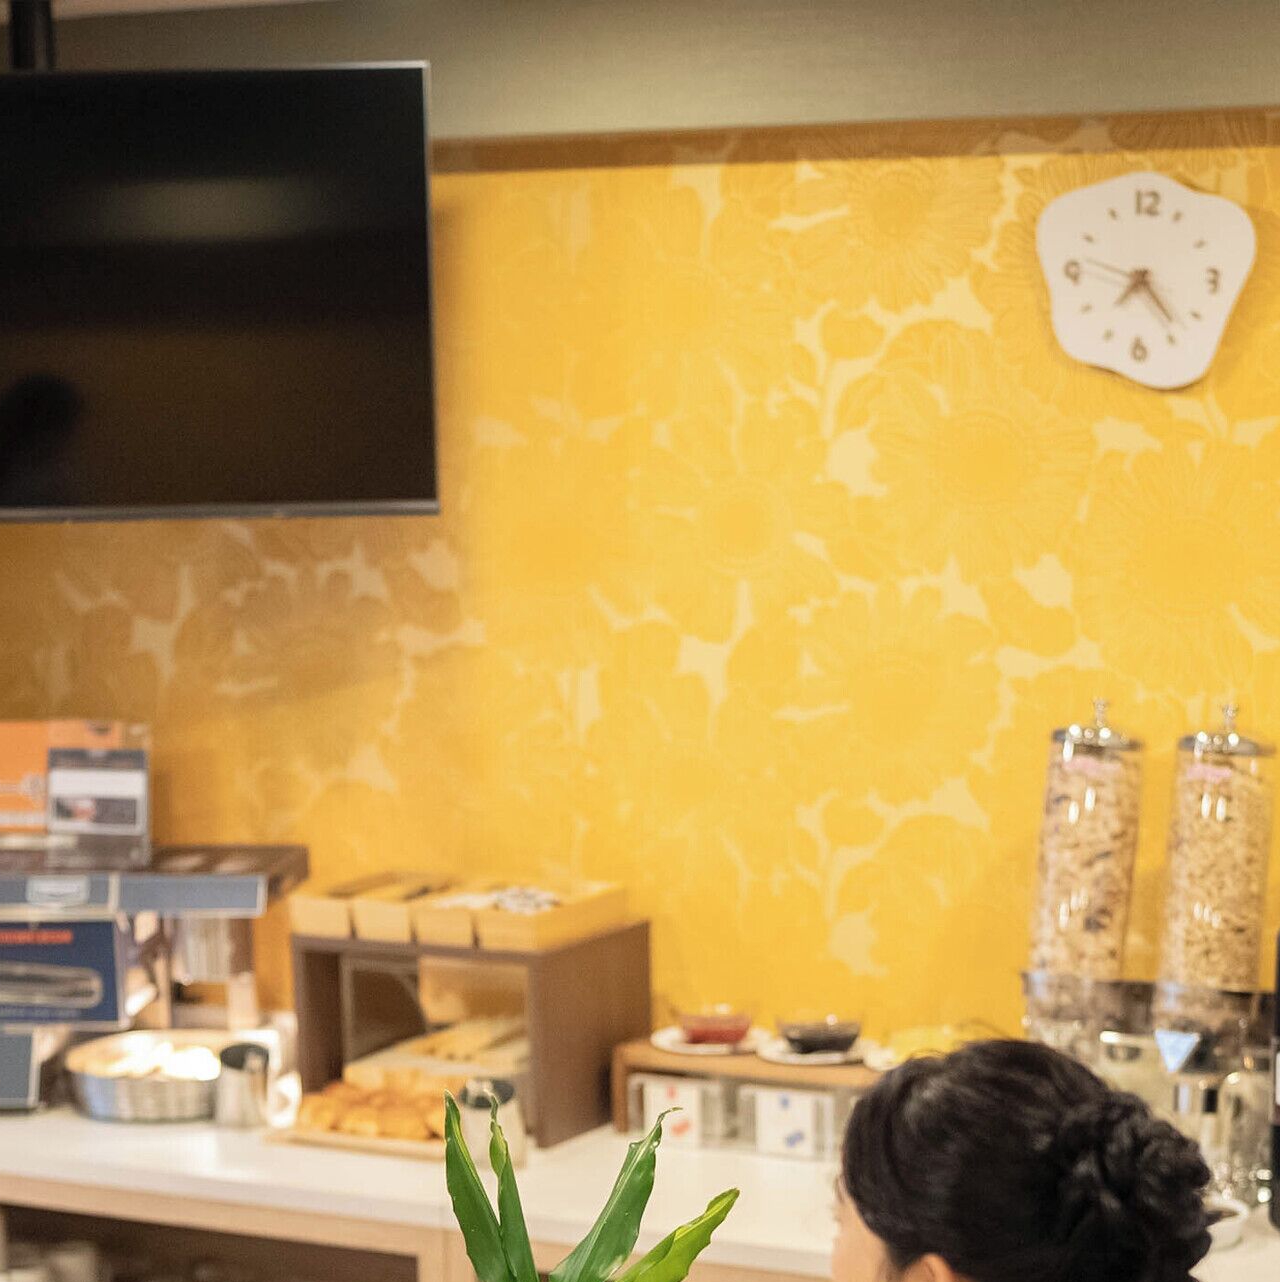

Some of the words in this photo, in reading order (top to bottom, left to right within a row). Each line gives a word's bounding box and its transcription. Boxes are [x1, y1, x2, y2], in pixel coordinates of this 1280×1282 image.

[1135, 190, 1160, 216] 12
[1064, 261, 1080, 284] 9
[1207, 268, 1219, 294] 3
[1131, 338, 1147, 361] 6
